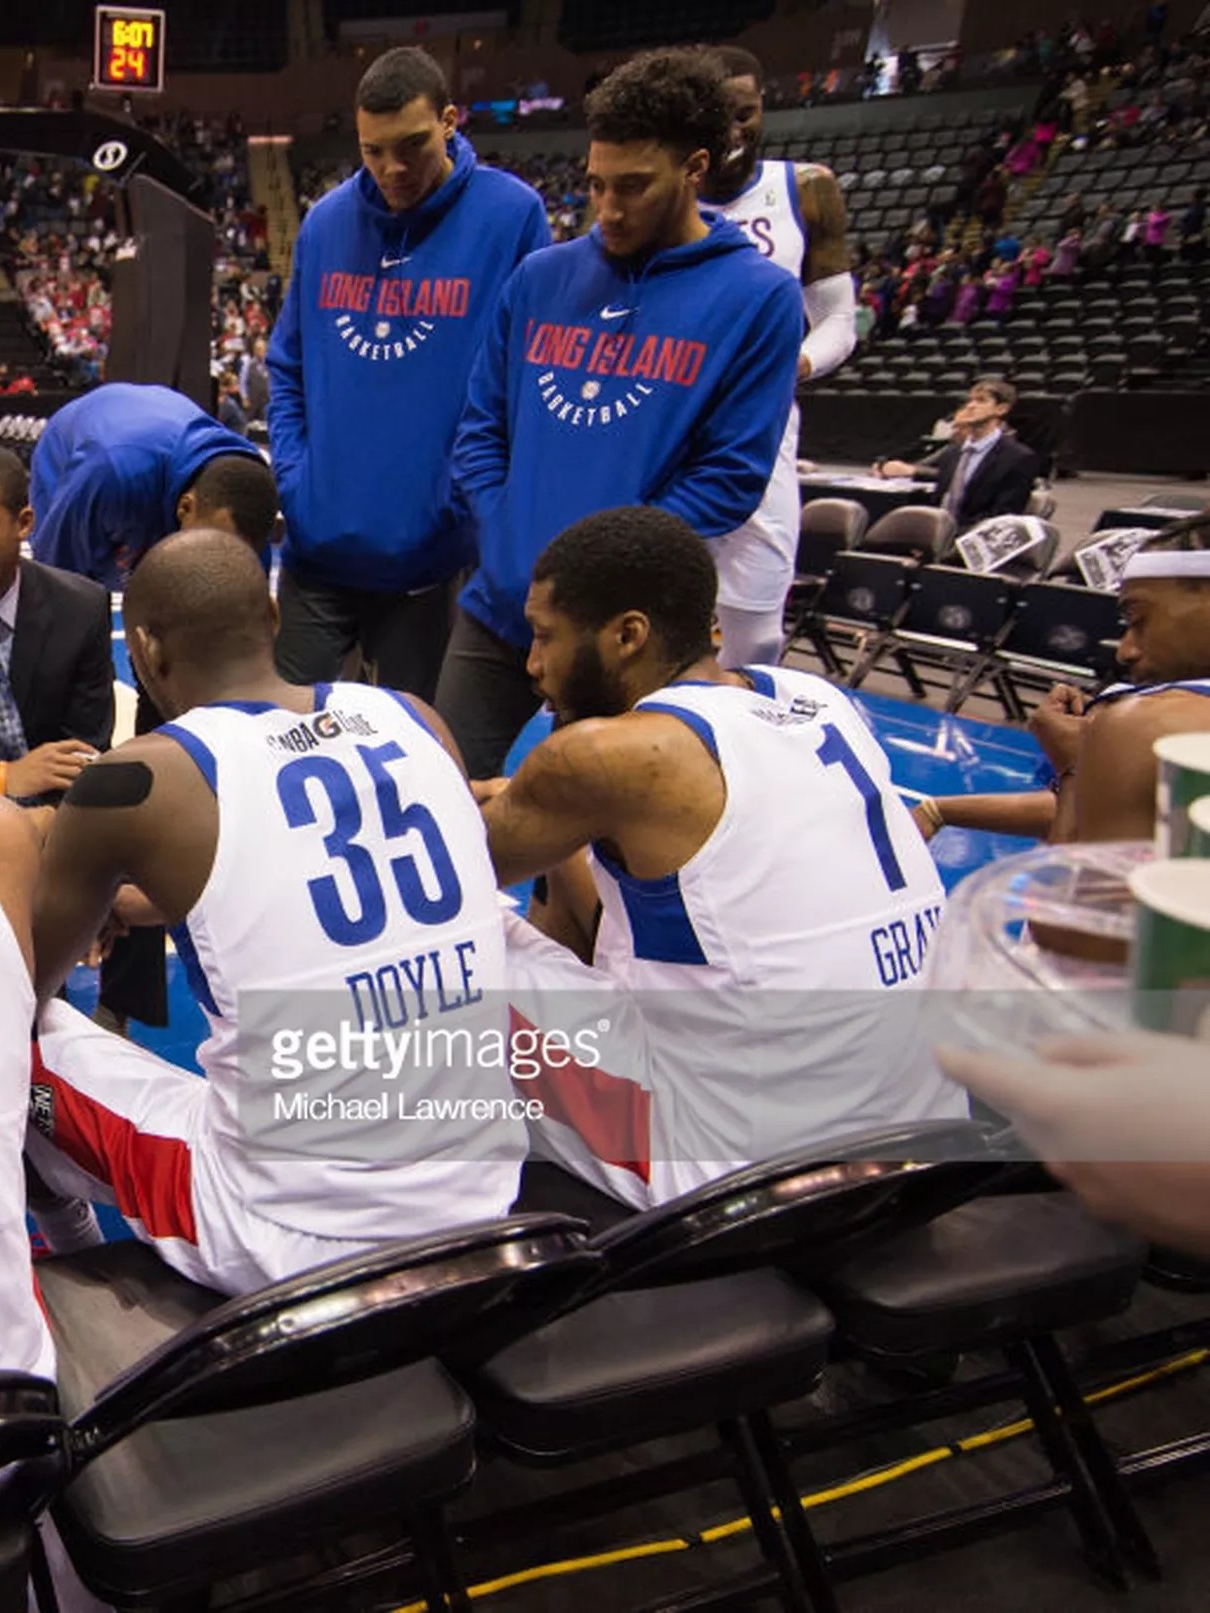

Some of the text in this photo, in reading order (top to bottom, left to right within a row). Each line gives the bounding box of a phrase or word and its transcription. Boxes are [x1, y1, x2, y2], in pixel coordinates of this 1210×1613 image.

[113, 20, 153, 48] 6:07
[110, 48, 145, 79] 24
[319, 271, 471, 317] LONG ISLAND
[335, 314, 435, 361] BASKETBALL
[525, 319, 708, 388] LONG ISLAND
[538, 371, 654, 427] BASKETBALL
[816, 722, 908, 893] 1
[276, 740, 464, 948] 35
[344, 940, 483, 1033] DOYLE
